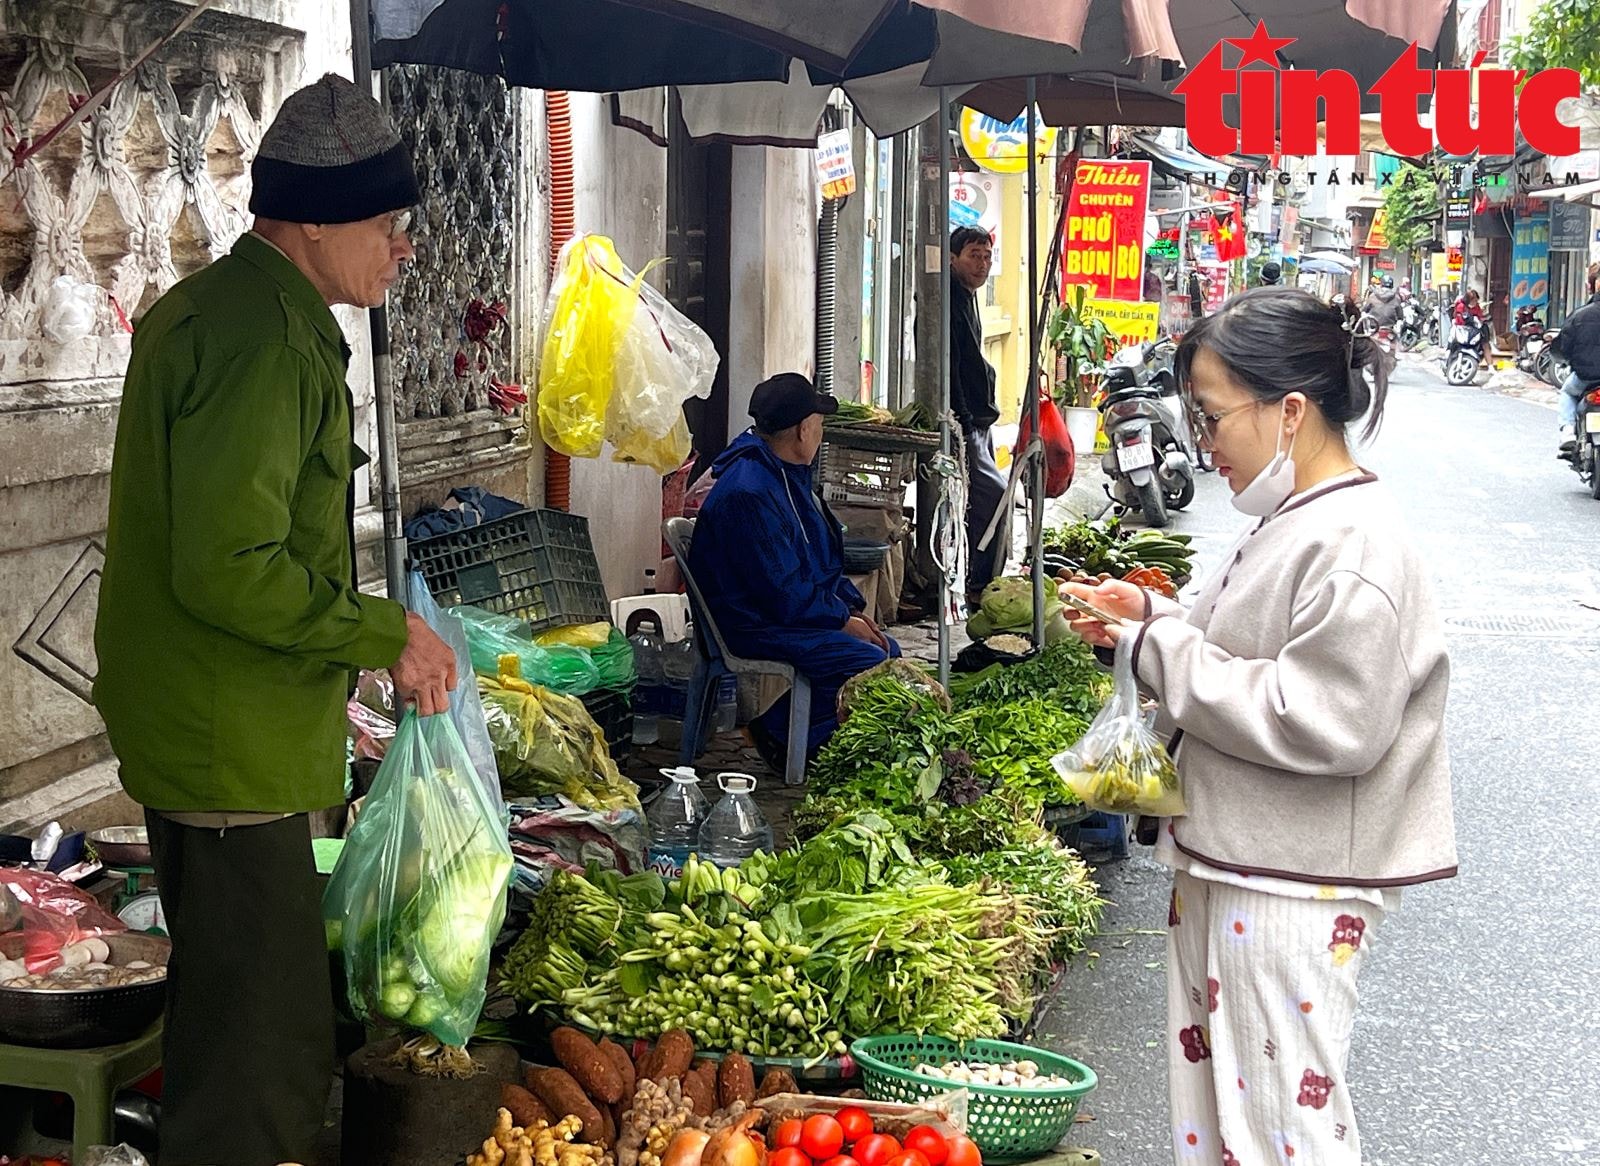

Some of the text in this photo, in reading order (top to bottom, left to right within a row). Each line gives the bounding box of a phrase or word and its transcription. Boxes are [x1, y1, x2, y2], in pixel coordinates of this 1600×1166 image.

[954, 189, 967, 201] 35
[1080, 193, 1133, 206] CHUYÊN
[1068, 211, 1112, 242] PHỞ
[1067, 246, 1111, 275] BÚN
[1116, 240, 1139, 280] BÒ
